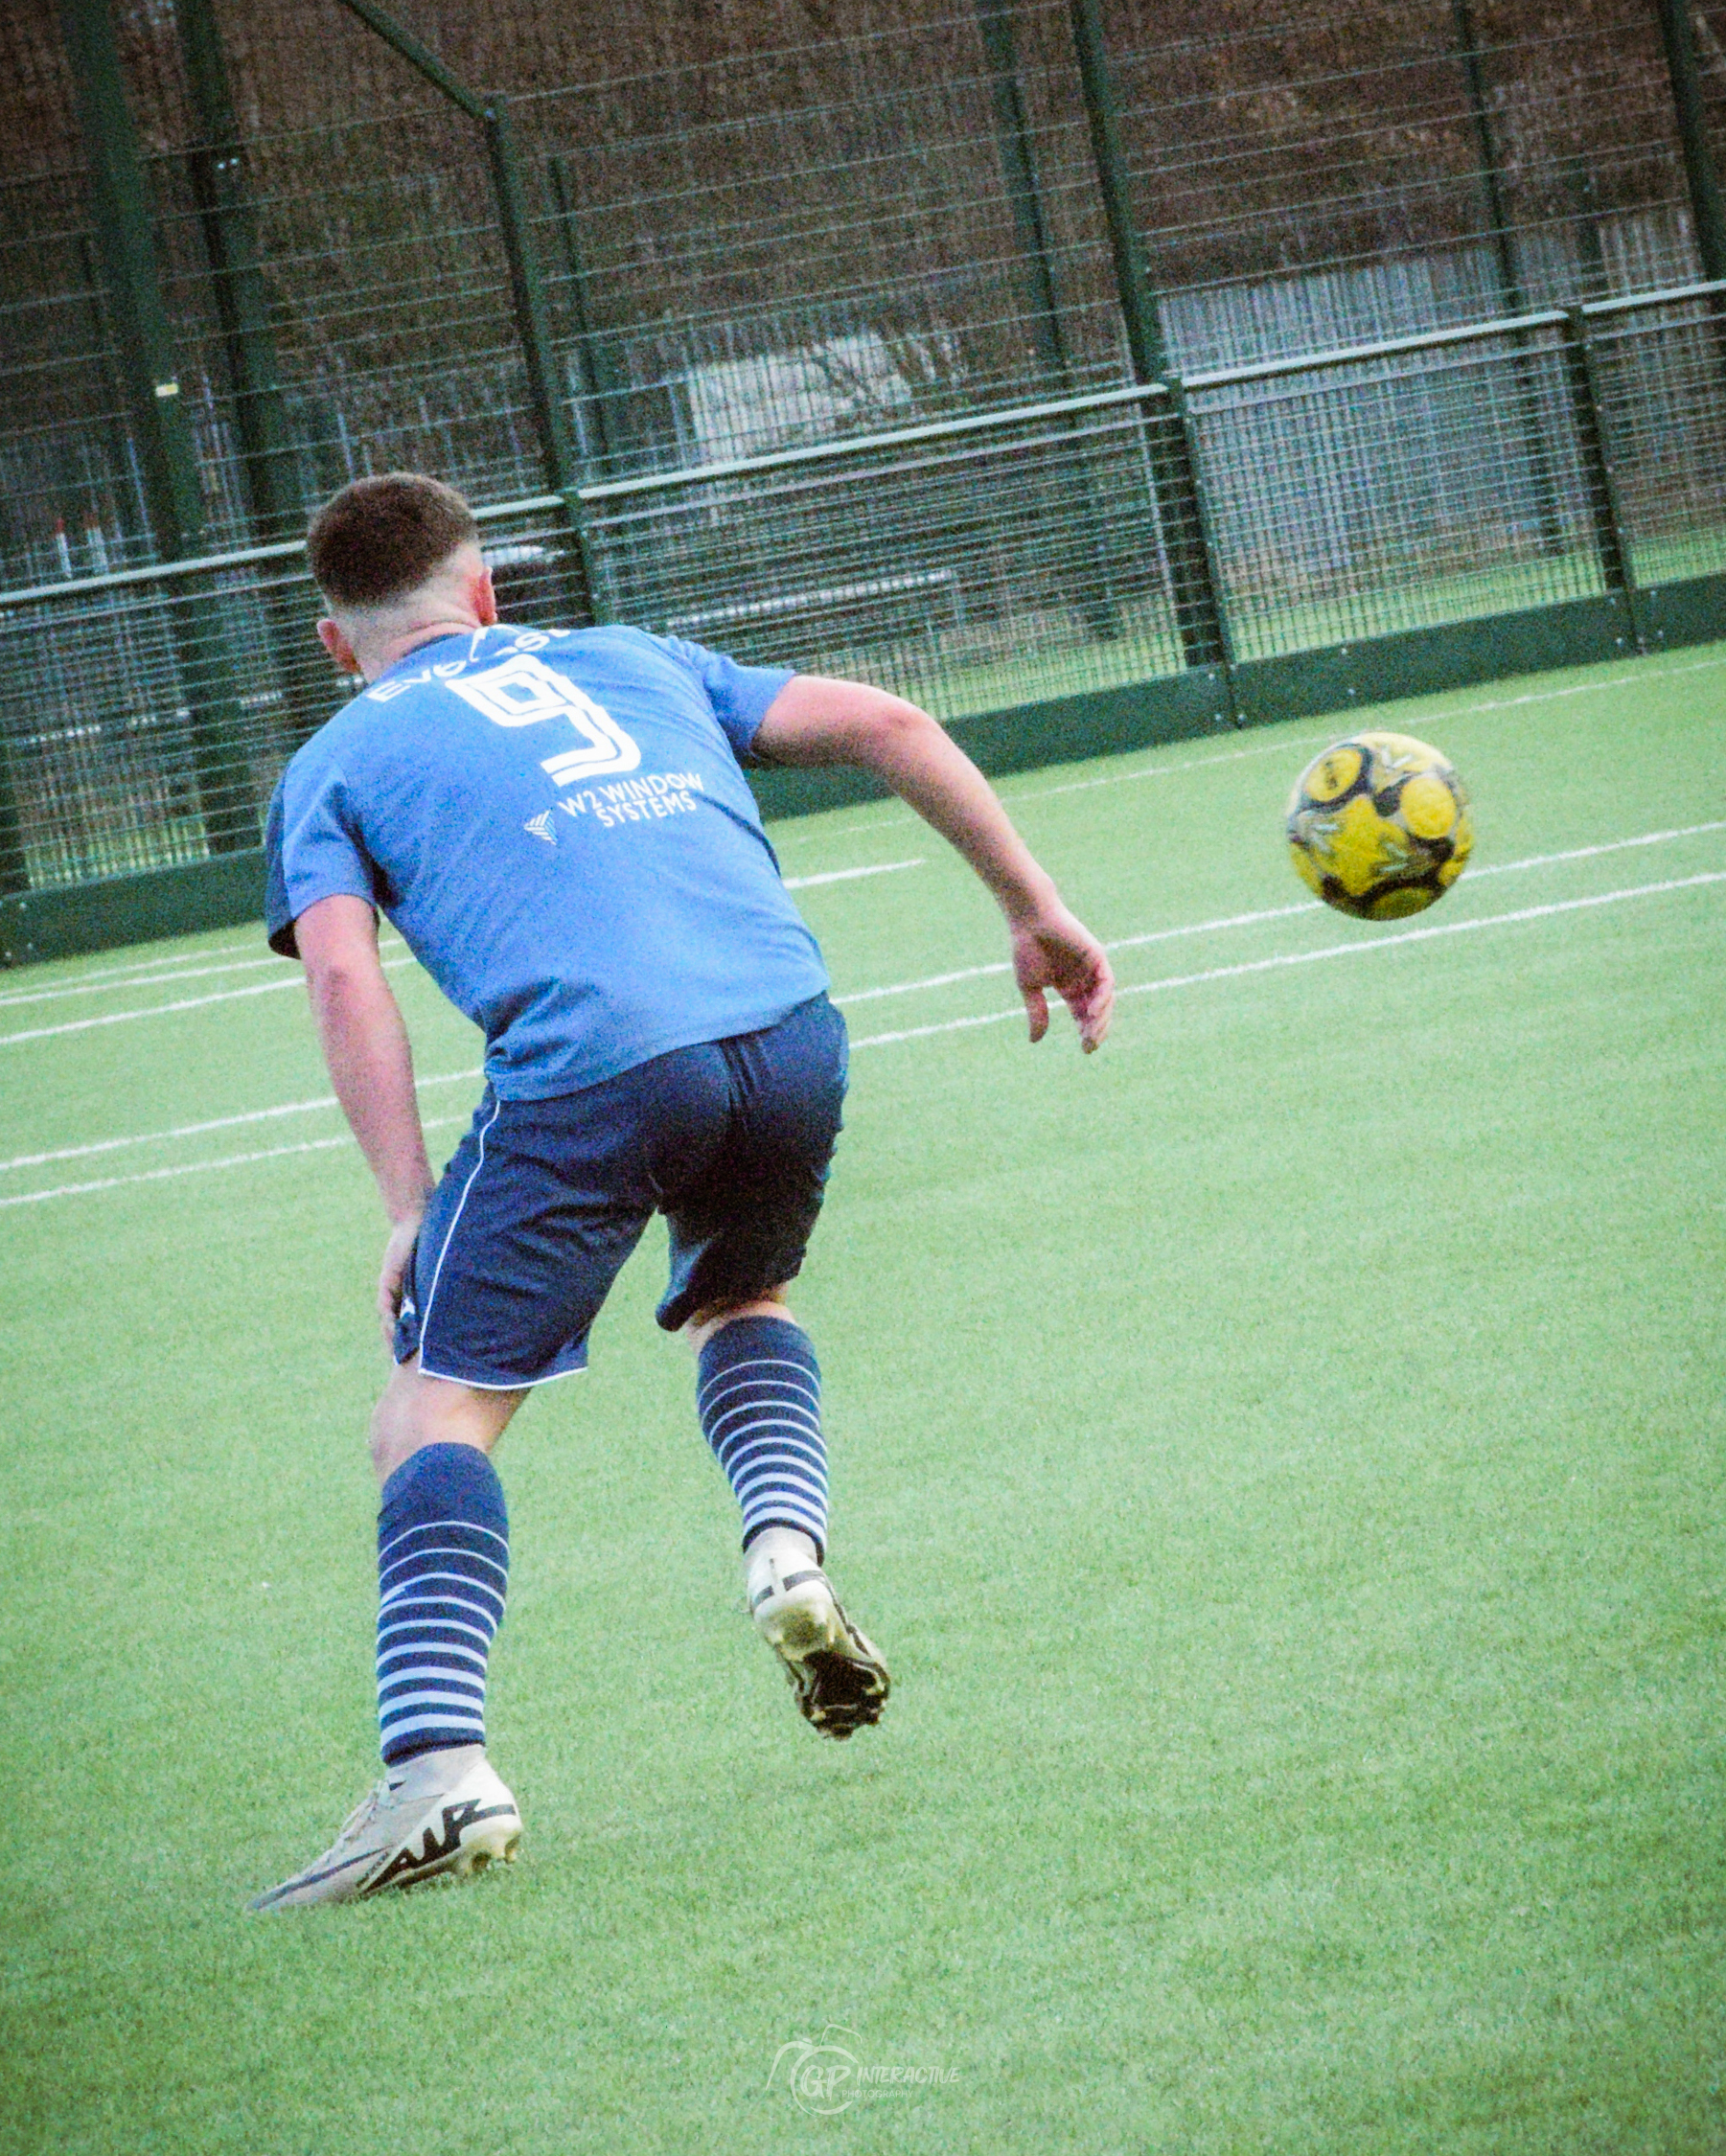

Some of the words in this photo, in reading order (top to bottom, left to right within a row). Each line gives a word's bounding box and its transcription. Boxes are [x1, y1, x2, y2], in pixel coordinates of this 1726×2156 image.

[445, 653, 641, 788] 9
[558, 791, 603, 817] W2
[598, 772, 704, 803] WINDOW
[596, 791, 697, 828] SYSTEMS
